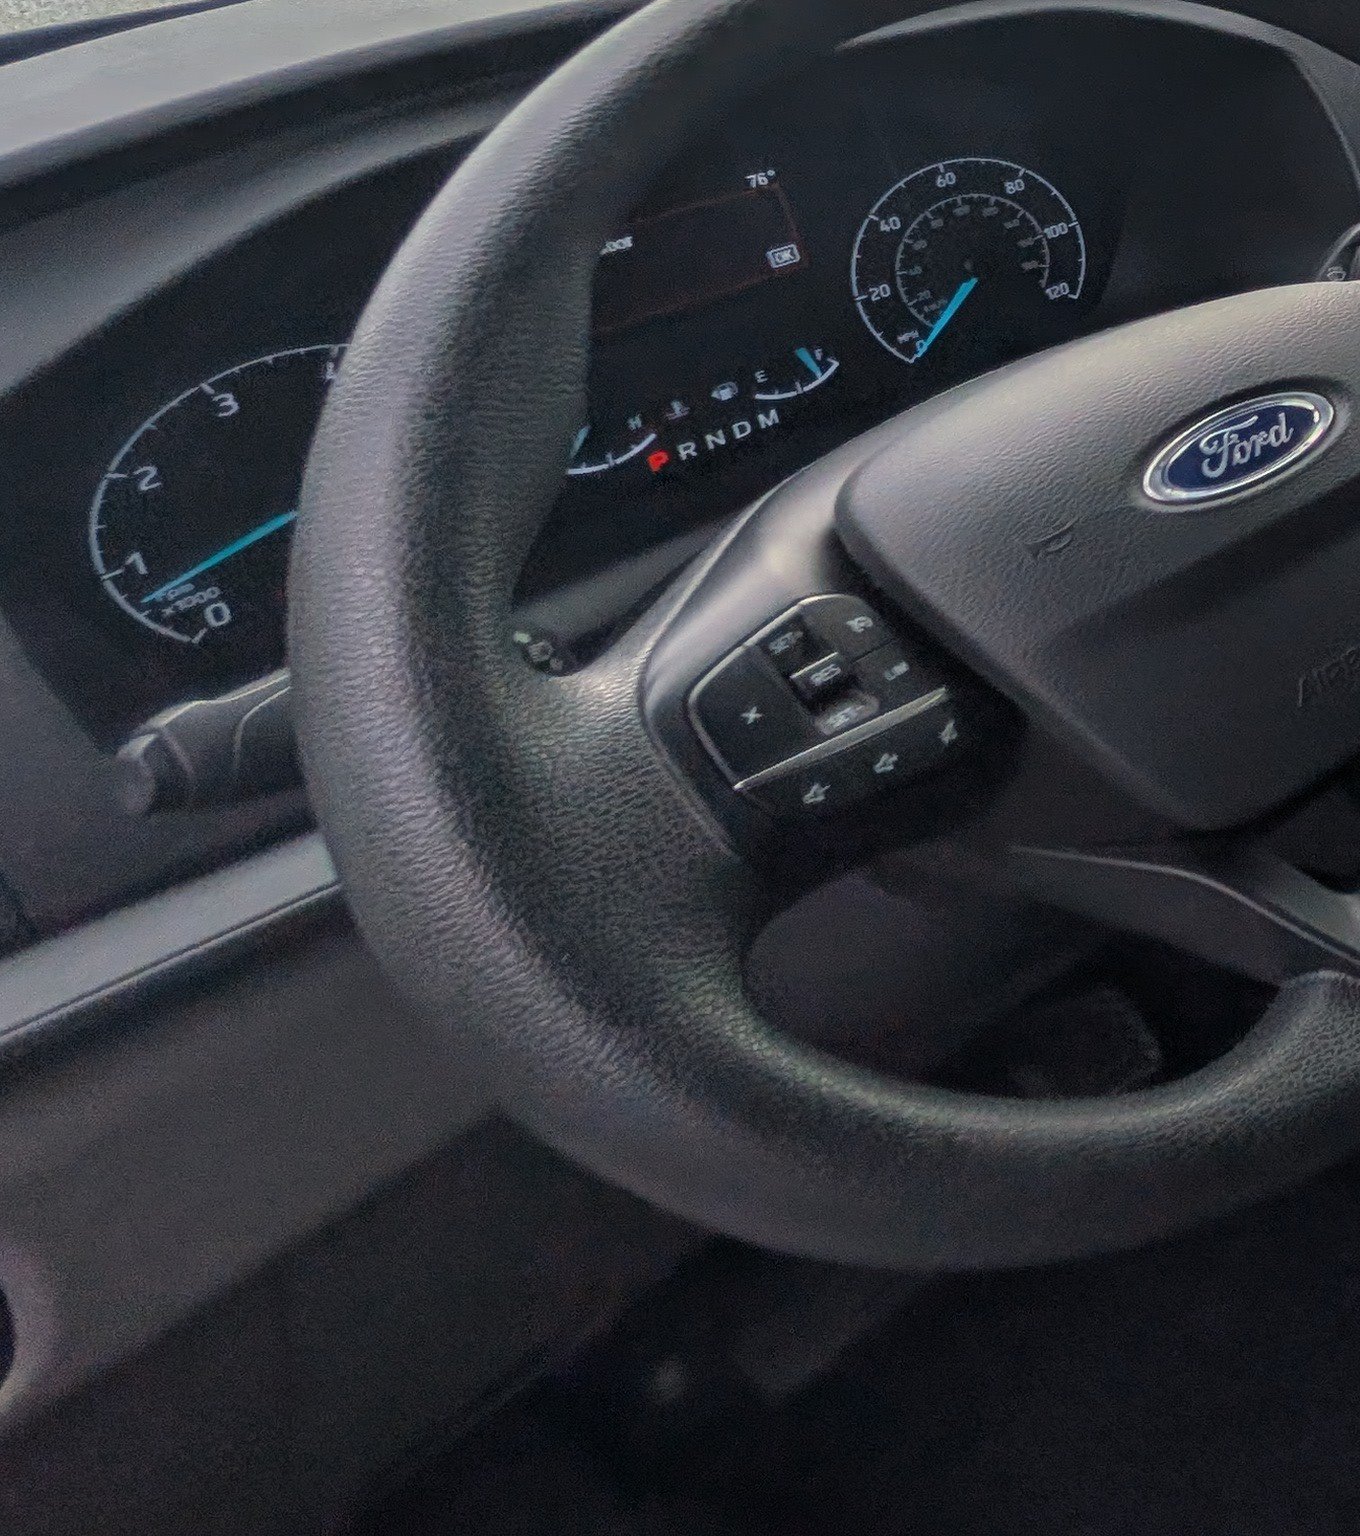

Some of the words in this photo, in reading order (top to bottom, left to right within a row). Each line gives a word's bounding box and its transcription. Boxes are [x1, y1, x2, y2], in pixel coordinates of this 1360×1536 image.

[935, 171, 957, 189] 60
[1003, 178, 1026, 195] 80
[879, 216, 902, 233] 40
[1043, 222, 1070, 239] 100
[868, 283, 892, 302] 20
[1044, 282, 1071, 301] 120
[212, 392, 241, 418] 3
[646, 449, 670, 473] P
[676, 440, 698, 462] R
[704, 428, 727, 451] N
[731, 420, 752, 440] D
[756, 408, 780, 430] M
[1198, 411, 1295, 479] Ford
[133, 465, 163, 492] 2
[125, 551, 149, 575] 1
[204, 602, 232, 628] 0
